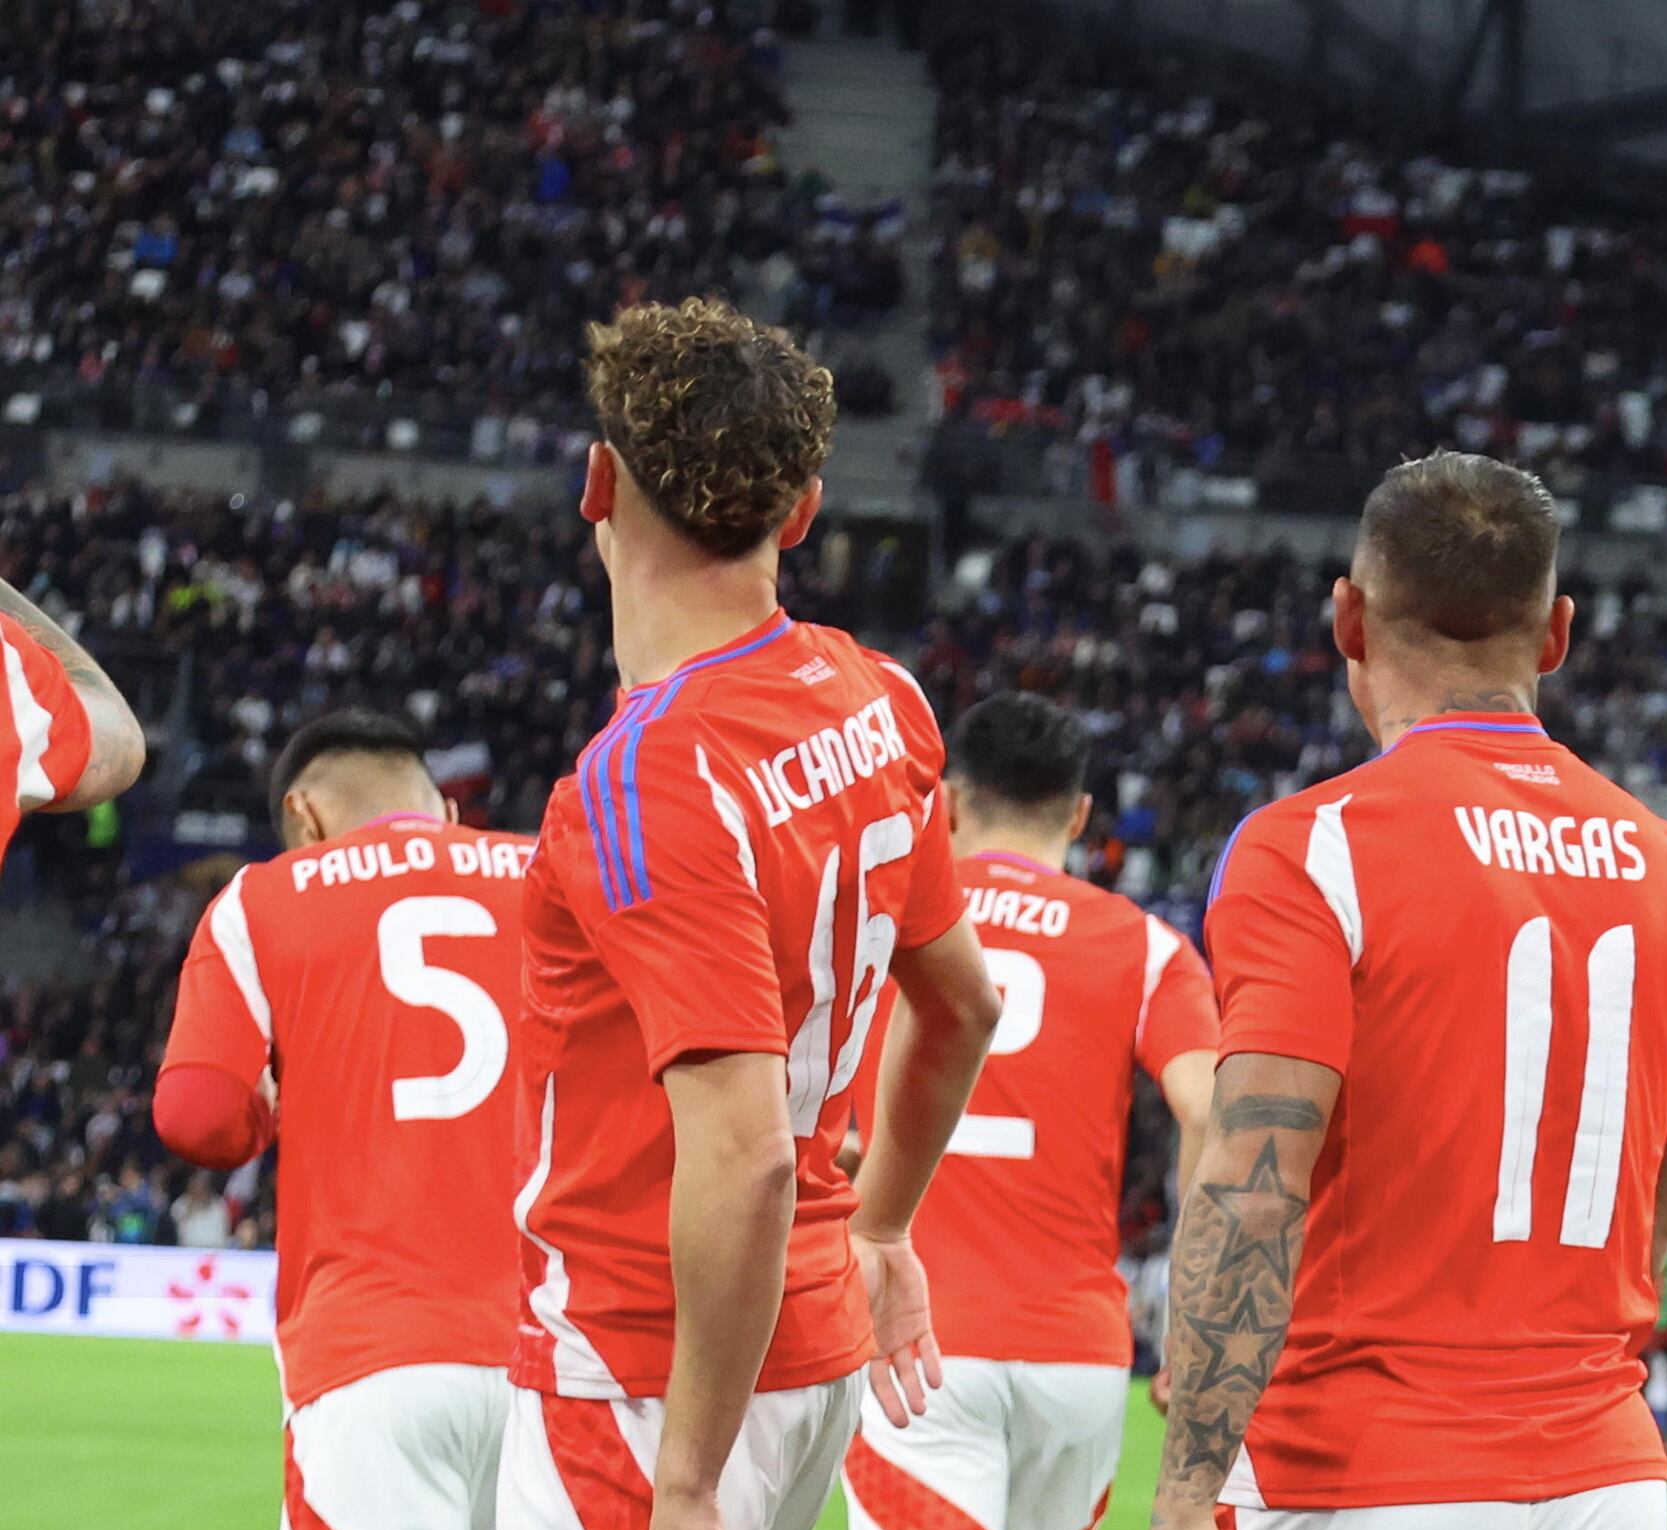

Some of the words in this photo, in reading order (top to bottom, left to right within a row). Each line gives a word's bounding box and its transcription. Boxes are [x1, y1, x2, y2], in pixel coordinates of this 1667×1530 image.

[291, 837, 436, 892] PAULO
[960, 887, 1071, 938] UAZO
[1454, 806, 1647, 881] VARGAS
[377, 896, 509, 1121] 5
[786, 811, 914, 1138] 16
[944, 947, 1046, 1160] 2
[1493, 915, 1636, 1249] 11
[12, 1260, 116, 1318] DF
